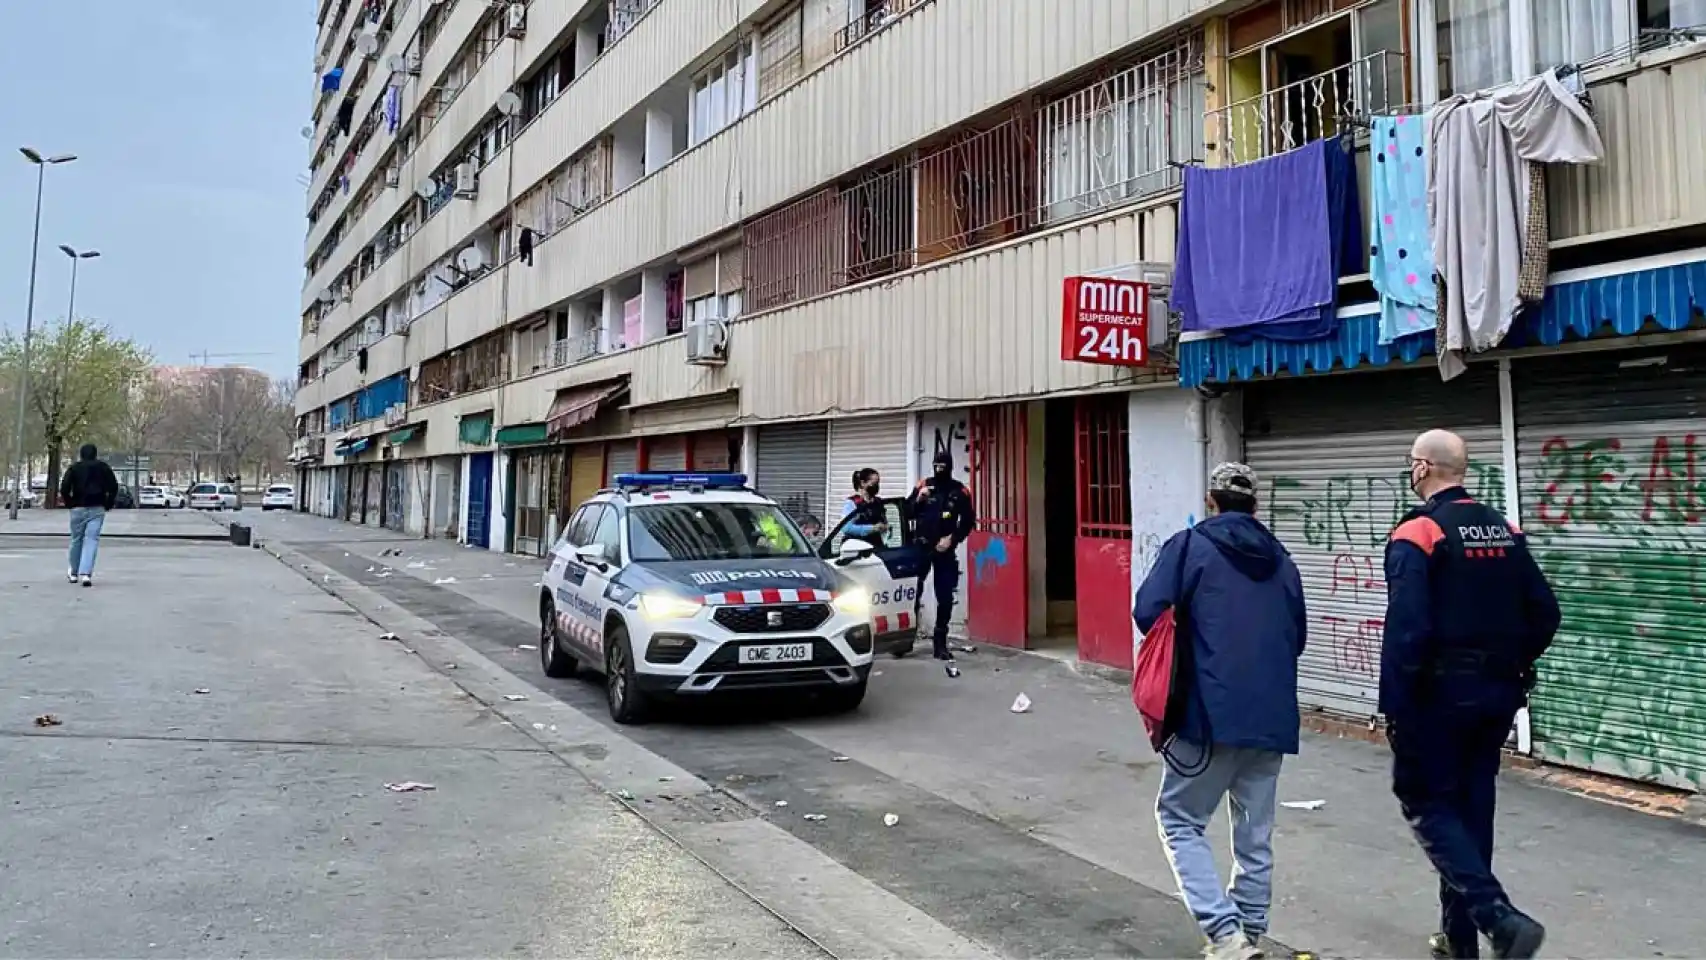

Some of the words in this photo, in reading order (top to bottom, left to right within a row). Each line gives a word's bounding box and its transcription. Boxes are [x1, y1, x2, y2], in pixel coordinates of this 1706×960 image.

[1079, 312, 1143, 326] SUPERMECAT
[1079, 326, 1142, 361] 24h
[1458, 525, 1512, 540] POLICIA
[727, 568, 817, 582] policia
[747, 647, 771, 661] CME
[776, 645, 806, 660] 2403
